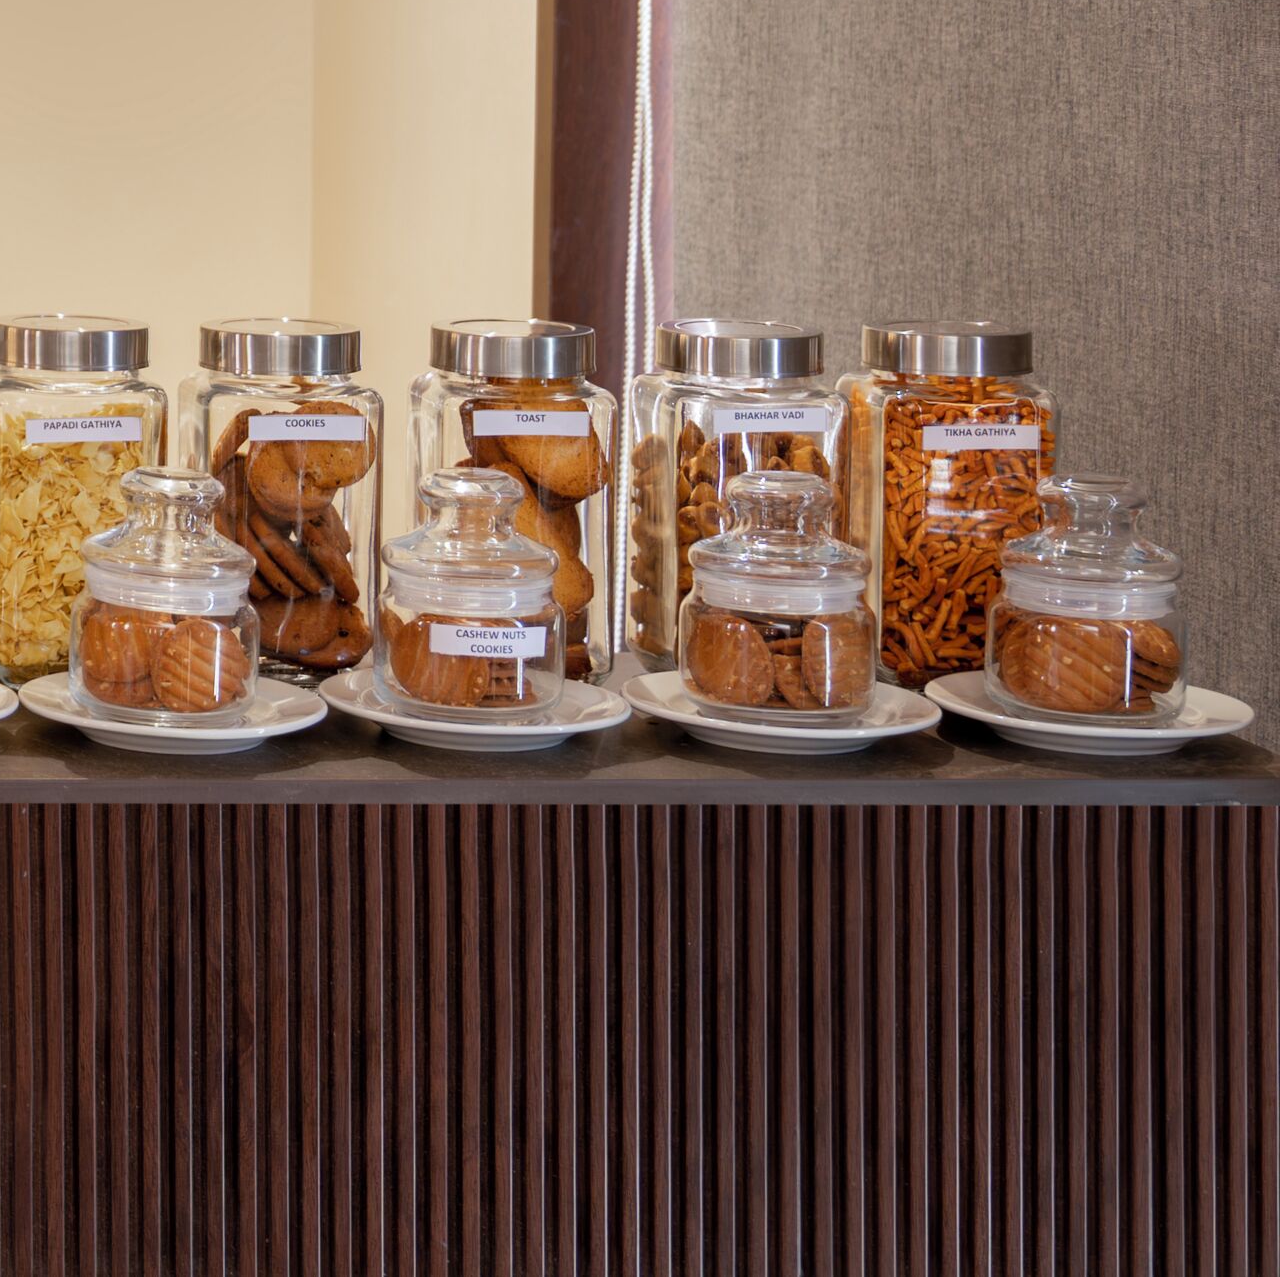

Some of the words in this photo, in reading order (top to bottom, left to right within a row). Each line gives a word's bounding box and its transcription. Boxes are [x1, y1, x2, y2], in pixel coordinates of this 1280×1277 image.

[515, 413, 546, 423] TOAST
[734, 411, 780, 421] BHAKHAR
[781, 410, 804, 420] VADI
[43, 421, 79, 430] PAPADI
[80, 419, 122, 429] GATHIYA
[285, 418, 326, 428] COOKIES
[944, 427, 972, 437] TIKHA
[974, 427, 1017, 437] GATHIYA
[455, 628, 500, 640] CASHEW
[501, 630, 527, 640] NUTS
[470, 644, 513, 654] COOKIES
